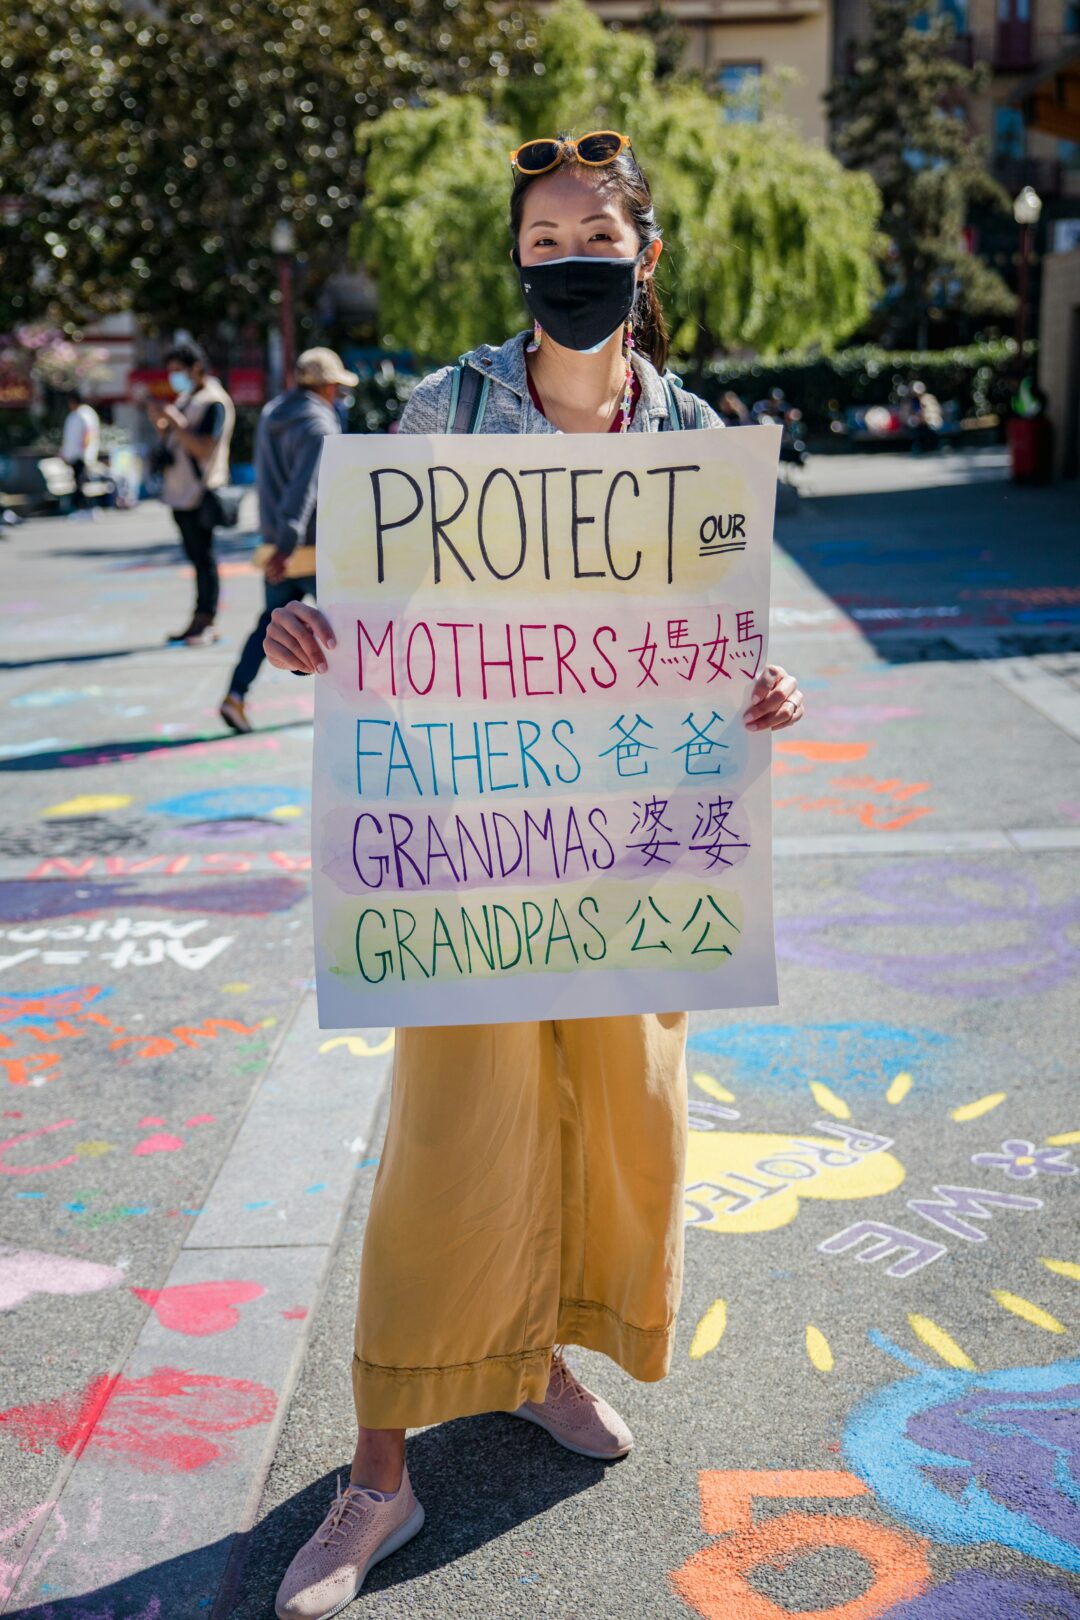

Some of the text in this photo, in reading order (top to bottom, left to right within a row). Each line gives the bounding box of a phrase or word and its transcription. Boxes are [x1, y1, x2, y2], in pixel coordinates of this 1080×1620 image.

[370, 465, 747, 584] PROTECT OUR
[356, 610, 764, 700] MOTHERS 媽媽
[356, 711, 729, 796] FATHERS 爸爸
[352, 806, 615, 888] GRANDMAS
[626, 794, 751, 870] 婆婆
[0, 917, 209, 943] Action
[355, 894, 741, 983] GRANDPAS 公公
[816, 1184, 1045, 1278] WE
